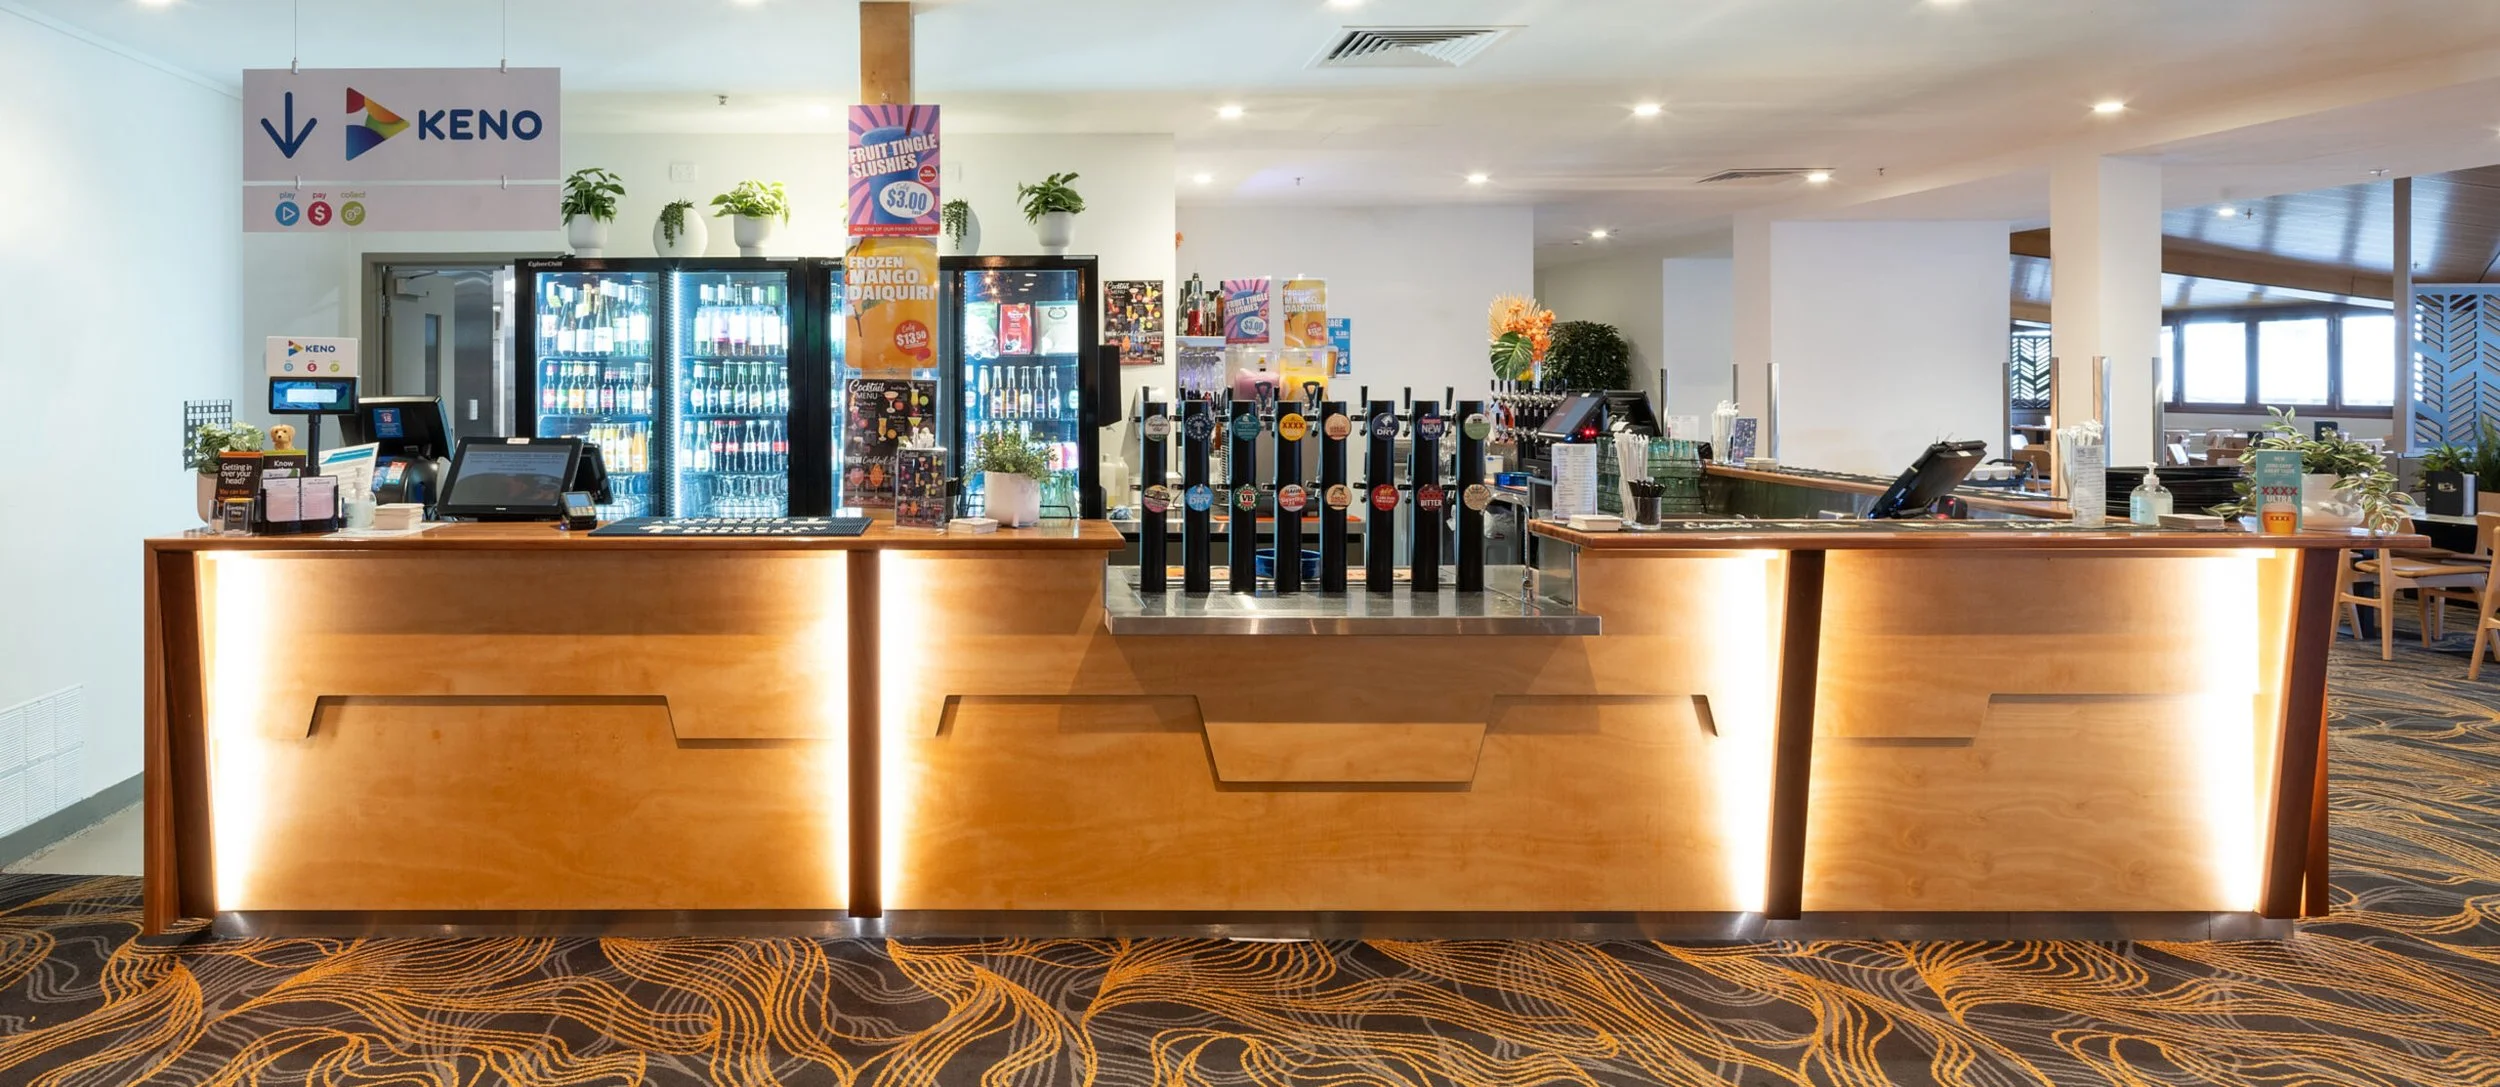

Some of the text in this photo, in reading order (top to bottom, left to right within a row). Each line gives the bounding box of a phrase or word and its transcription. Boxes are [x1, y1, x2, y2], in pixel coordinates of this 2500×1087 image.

[418, 109, 543, 141] KENO
[848, 134, 937, 163] FRUIT TINGLE
[851, 154, 918, 178] SLUSHIES
[279, 191, 296, 200] play
[312, 192, 327, 200] pay
[340, 191, 366, 199] collect
[887, 188, 927, 210] $3.00
[849, 256, 904, 269] FROZEN
[849, 269, 919, 285] MANGO
[849, 285, 936, 302] DAIQUIRI
[1247, 292, 1268, 305] TINGLE
[1284, 296, 1318, 304] MANGO
[1227, 303, 1259, 316] SLUSHIES
[1284, 304, 1327, 313] DAIQUIRI
[1244, 320, 1264, 331] $3.00
[305, 345, 336, 353] KENO
[849, 380, 885, 394] Cocktail
[856, 392, 878, 400] MENU
[1376, 428, 1395, 436] DRY
[1421, 424, 1441, 433] NEW
[221, 462, 253, 472] Getting in
[236, 471, 251, 479] your
[2261, 486, 2298, 495] XXXX
[2266, 495, 2293, 503] ULTRA
